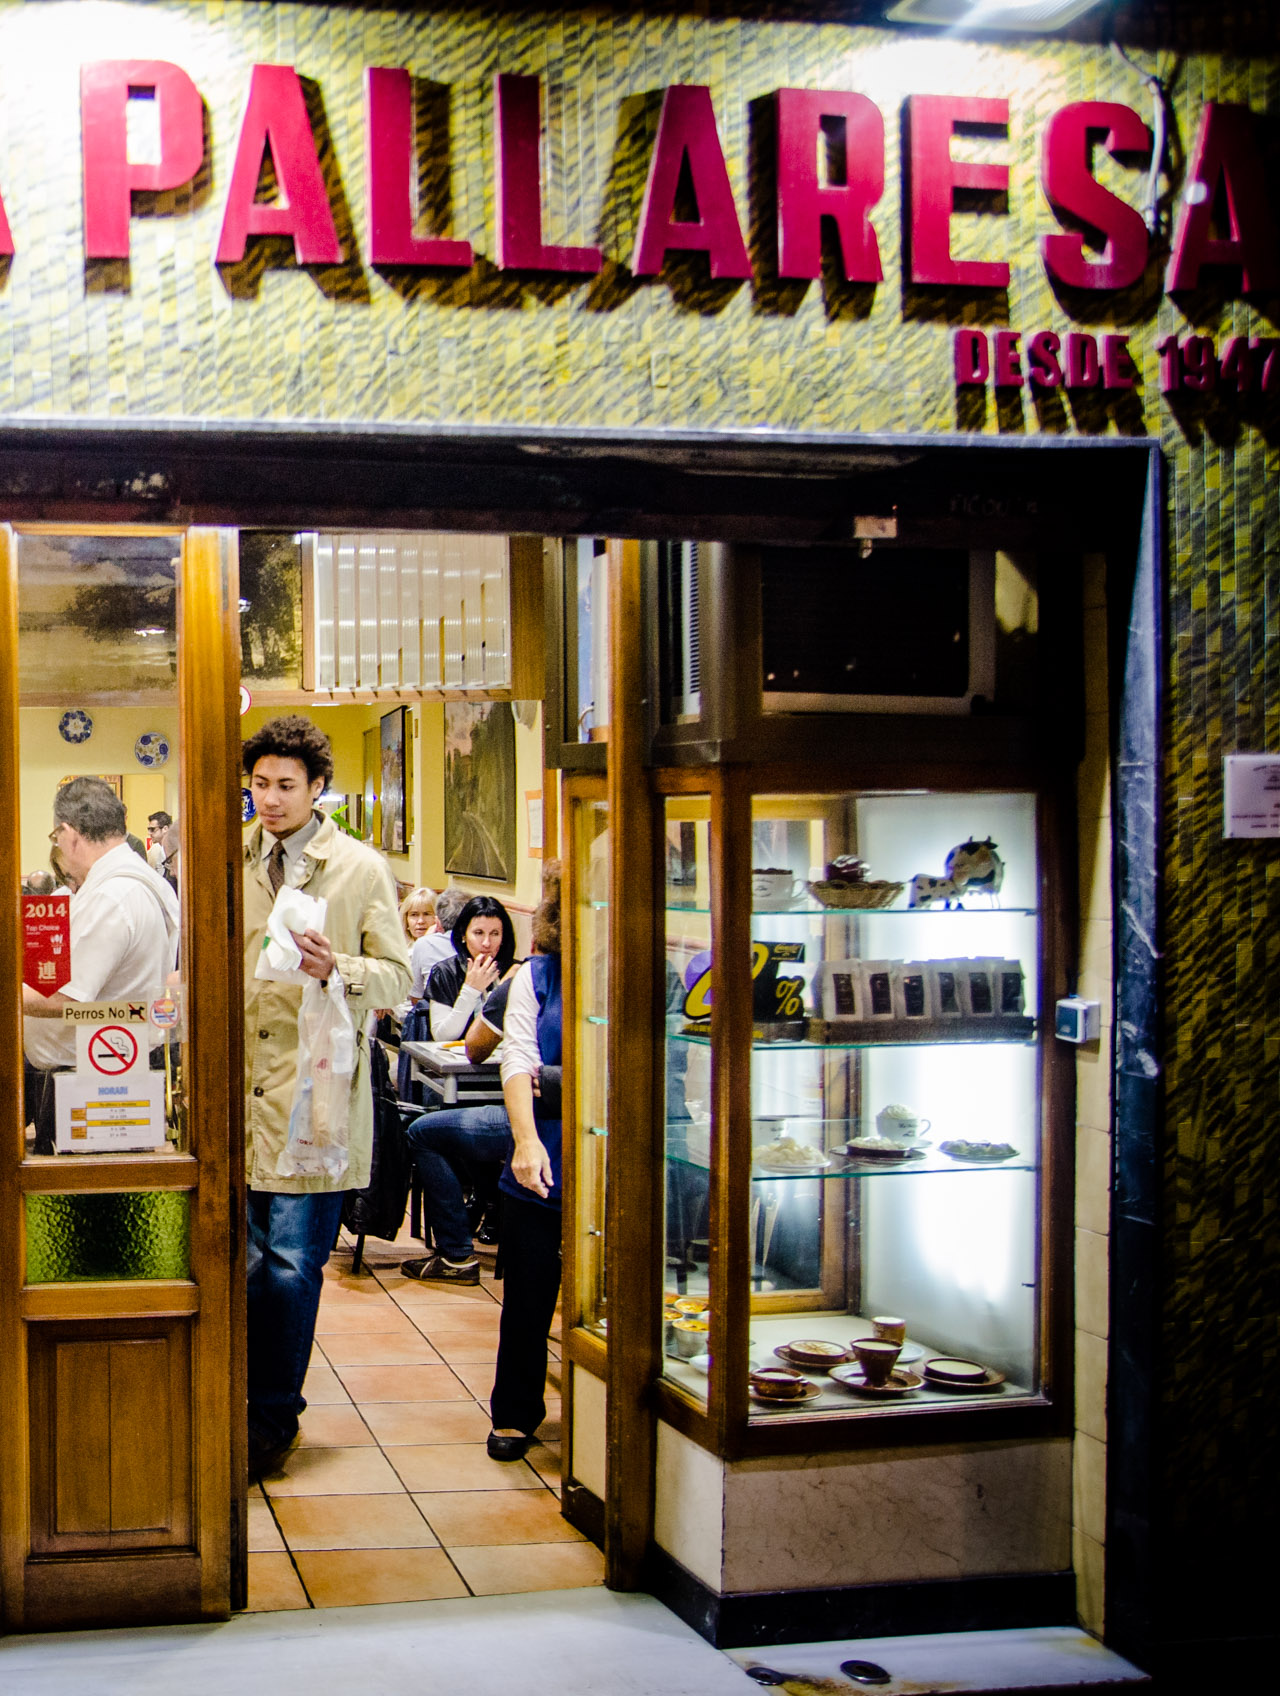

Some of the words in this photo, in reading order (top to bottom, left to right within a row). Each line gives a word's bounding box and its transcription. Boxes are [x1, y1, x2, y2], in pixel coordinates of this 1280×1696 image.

[78, 58, 1280, 296] PALLARESA
[954, 329, 1134, 391] DESDE
[1156, 334, 1280, 394] 1947
[24, 903, 67, 918] 2014
[65, 1007, 105, 1020] Perros
[108, 1006, 125, 1019] No
[97, 1086, 129, 1096] HORARI
